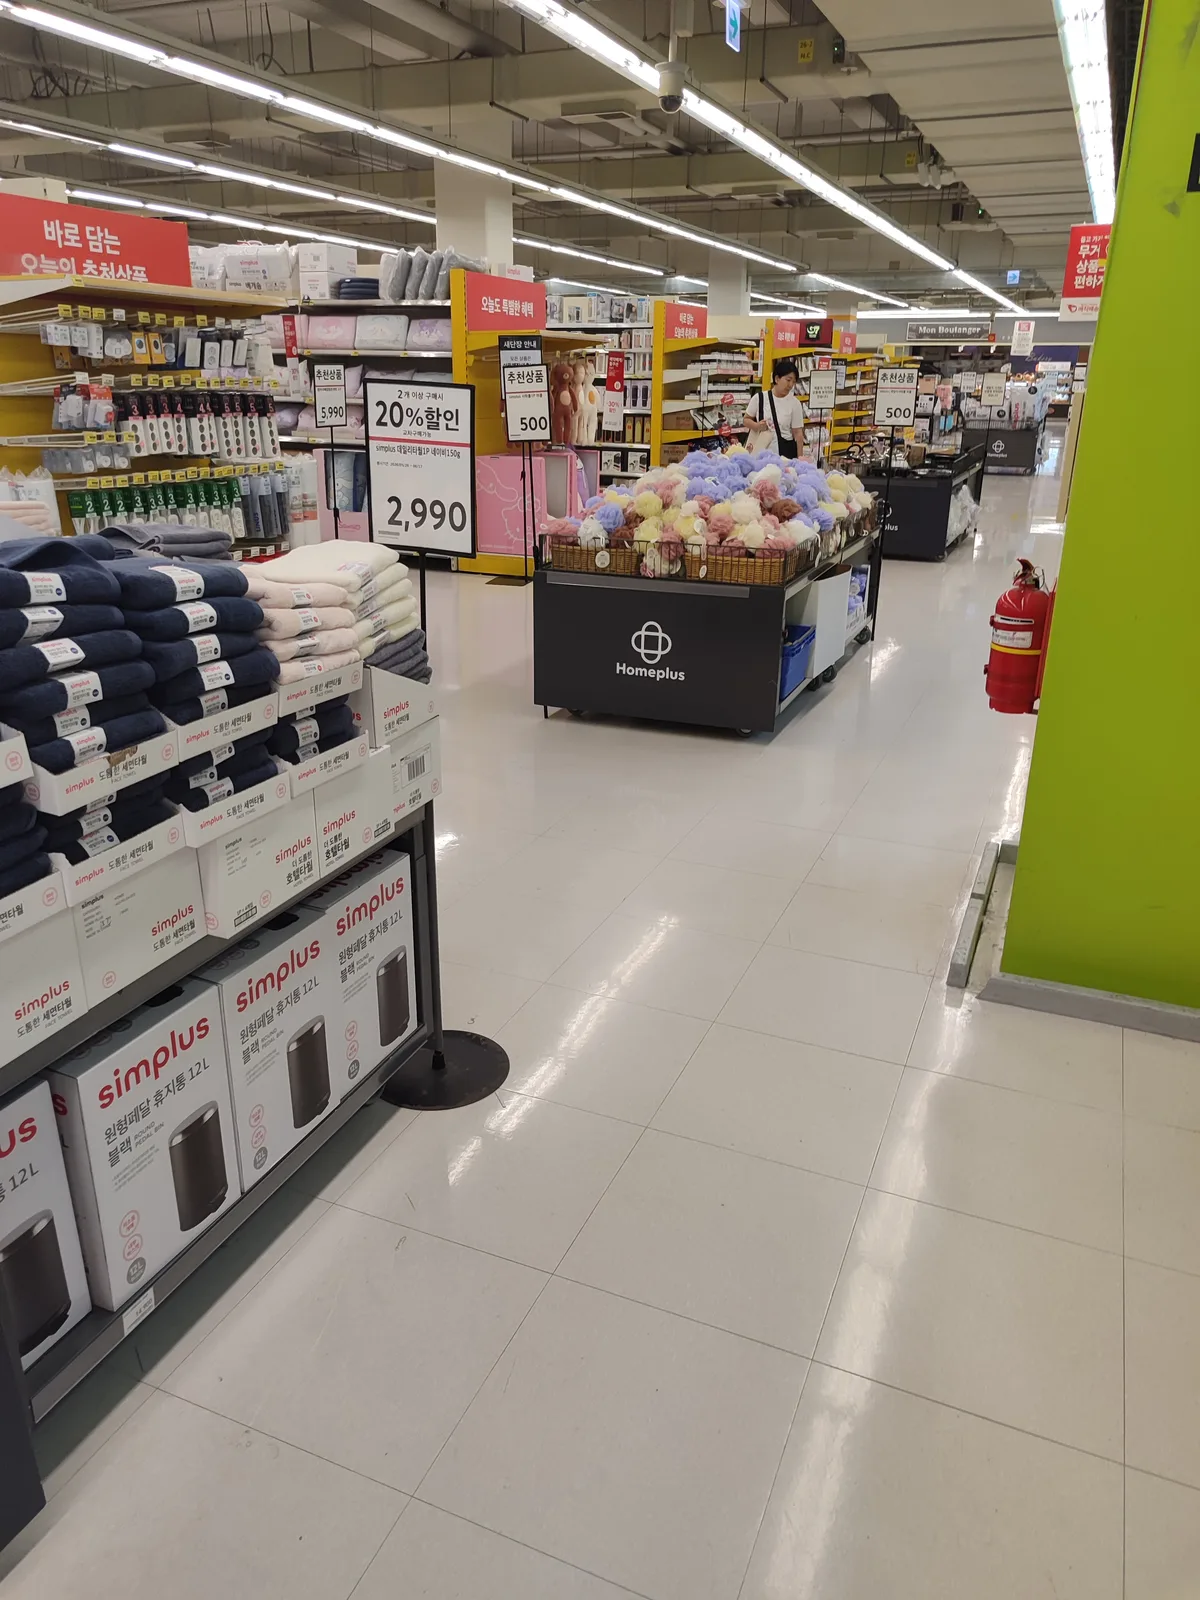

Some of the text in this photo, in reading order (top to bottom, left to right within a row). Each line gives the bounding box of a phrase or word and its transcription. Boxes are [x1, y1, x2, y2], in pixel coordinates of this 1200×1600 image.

[43, 219, 121, 256] 바로 담는
[481, 296, 535, 319] 오늘도 특별한 혜택
[918, 326, 937, 334] Mon
[503, 340, 537, 349] 새단장 안내
[315, 368, 342, 381] 추천상품
[507, 369, 545, 385] 추천상품
[880, 372, 915, 384] 추천상품
[397, 389, 444, 401] 2개 이상 구매시
[132, 405, 139, 416] 3
[163, 402, 169, 413] 3
[176, 403, 183, 413] 4
[199, 403, 206, 413] 4
[224, 402, 231, 412] 5
[235, 402, 241, 412] 5
[321, 406, 344, 420] 5,990
[885, 407, 911, 419] 500
[375, 400, 460, 431] 20%할인
[520, 416, 548, 431] 500
[375, 444, 396, 453] simplus
[157, 494, 164, 505] 3
[168, 493, 175, 504] 3
[187, 493, 195, 503] 3
[200, 491, 206, 502] 3
[213, 490, 220, 500] 3
[222, 494, 229, 504] 3
[233, 487, 240, 497] 3
[86, 501, 94, 512] 2
[102, 500, 110, 510] 2
[117, 500, 125, 511] 2
[135, 496, 143, 508] 3
[150, 498, 157, 509] 3
[387, 495, 467, 532] 2,990
[615, 661, 686, 681] Homeplus
[286, 690, 307, 701] simplus
[383, 700, 410, 719] simplus
[186, 729, 210, 744] simplus
[230, 712, 252, 728] 세면타월
[65, 777, 95, 795] simplus
[121, 754, 148, 771] 세면타월
[298, 767, 317, 781] simplus
[199, 813, 223, 830] simplus
[243, 793, 265, 810] 세면타월
[323, 809, 356, 836] simplus
[275, 836, 312, 864] simplus
[324, 837, 350, 861] 호텔타월
[75, 866, 105, 887] simplus
[108, 853, 128, 871] 도톰한
[129, 840, 154, 860] 세면타월
[291, 859, 298, 868] 더
[285, 859, 313, 885] 호텔타월
[336, 877, 405, 936] simplus
[151, 903, 194, 937] simplus
[152, 918, 196, 953] 도톰한 세면타월
[338, 910, 404, 965] 원형페달 휴지통 12L
[356, 953, 370, 966] ROUND
[356, 960, 368, 972] PEDAL
[236, 940, 321, 1012] simplus
[339, 962, 356, 985] 블랙
[14, 980, 70, 1021] simplus
[16, 995, 73, 1039] 도톰한 세면타월
[239, 1007, 275, 1045] 원형페달
[276, 989, 302, 1017] 휴지통
[302, 975, 320, 997] 12L
[44, 1008, 73, 1030] FACE TOWEL
[260, 1027, 278, 1043] ROUND
[261, 1028, 284, 1050] PEDAL BIN
[241, 1037, 261, 1065] 블랙
[98, 1017, 210, 1110] simplus
[103, 1097, 152, 1146] 원형페달
[152, 1072, 187, 1110] 휴지통
[187, 1057, 211, 1082] 12L
[133, 1120, 156, 1141] ROUND
[134, 1121, 165, 1149] PEDAL BIN
[107, 1135, 133, 1169] 블랙
[8, 1162, 40, 1193] 12L
